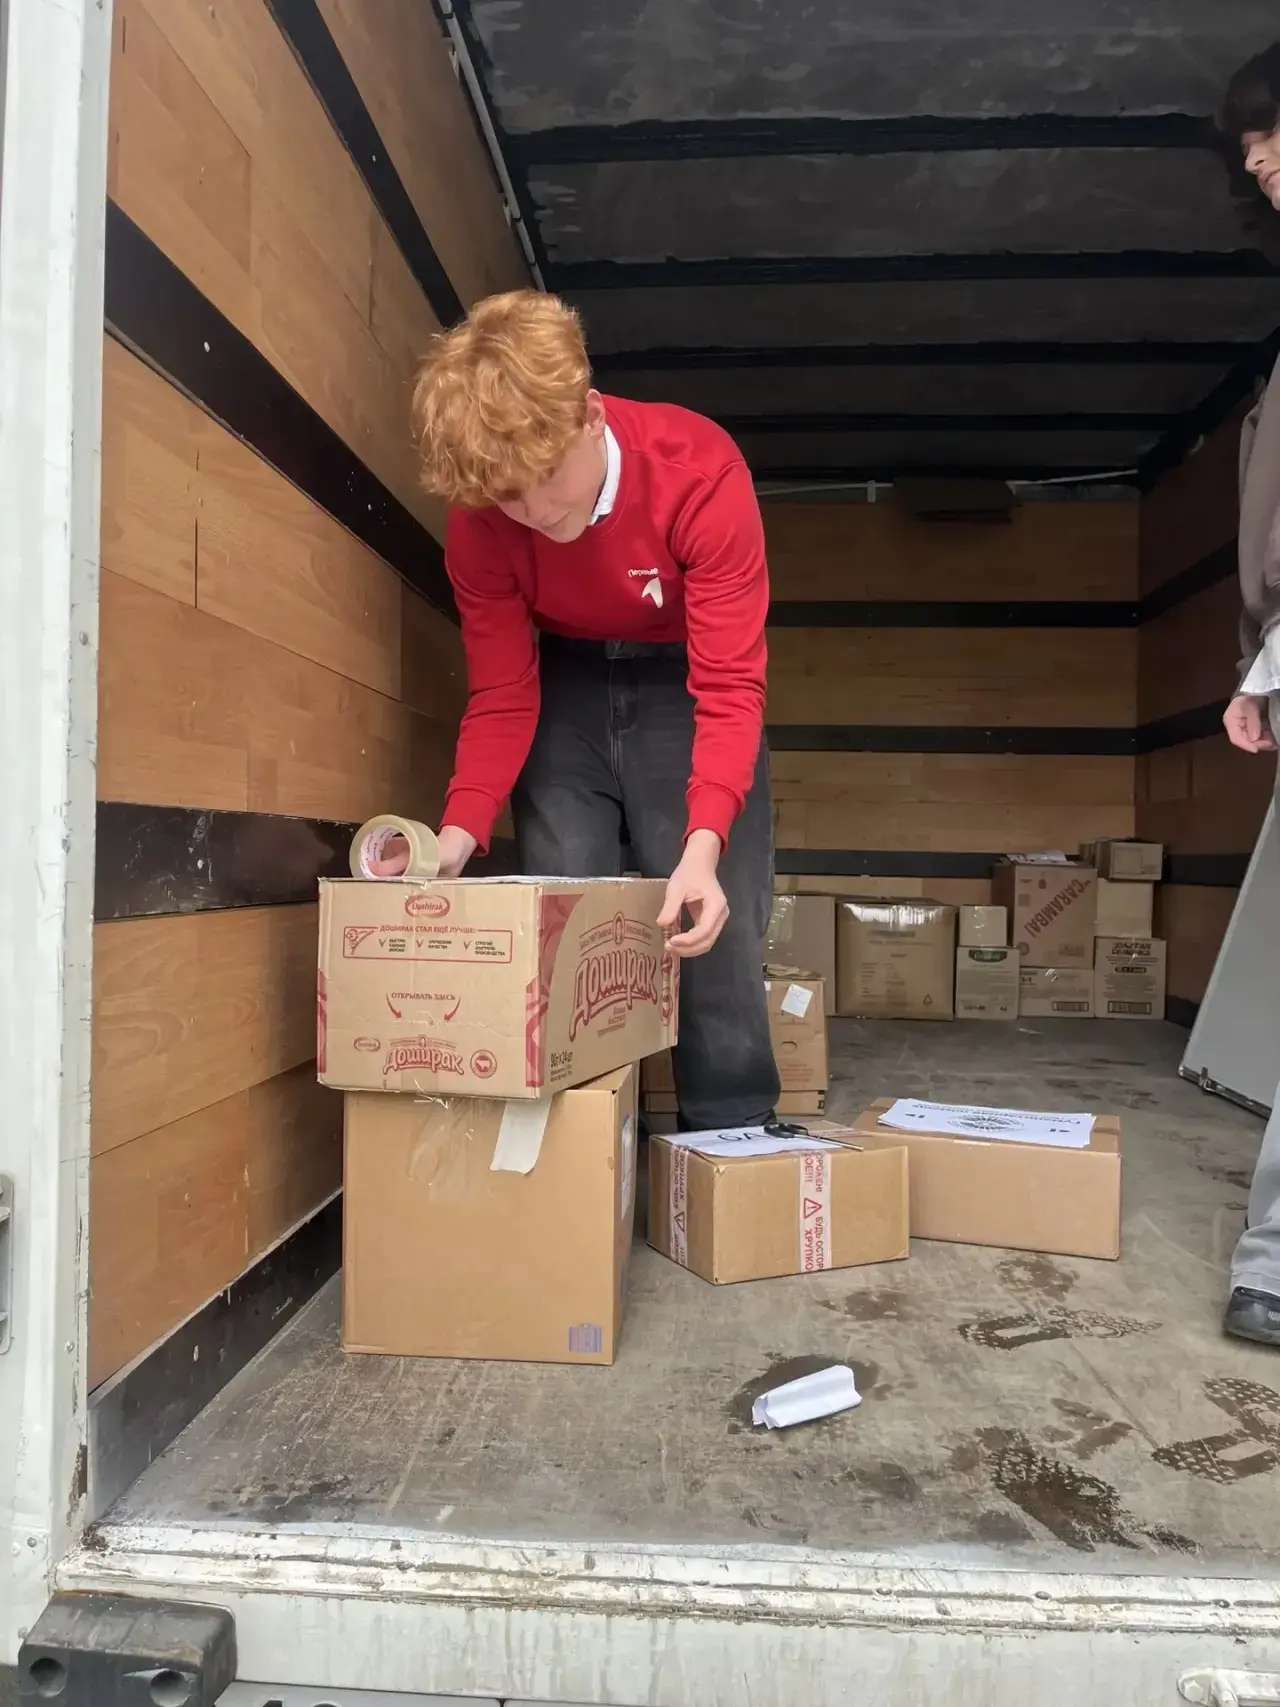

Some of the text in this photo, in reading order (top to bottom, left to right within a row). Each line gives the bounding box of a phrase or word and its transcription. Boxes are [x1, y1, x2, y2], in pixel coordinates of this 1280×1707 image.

[411, 902, 443, 911] Doshirak
[391, 992, 432, 1000] ОТКРЫВАТЬ
[383, 1048, 464, 1075] Доширак
[815, 1217, 823, 1238] БУДЬ
[804, 1229, 813, 1271] ХРУПКО
